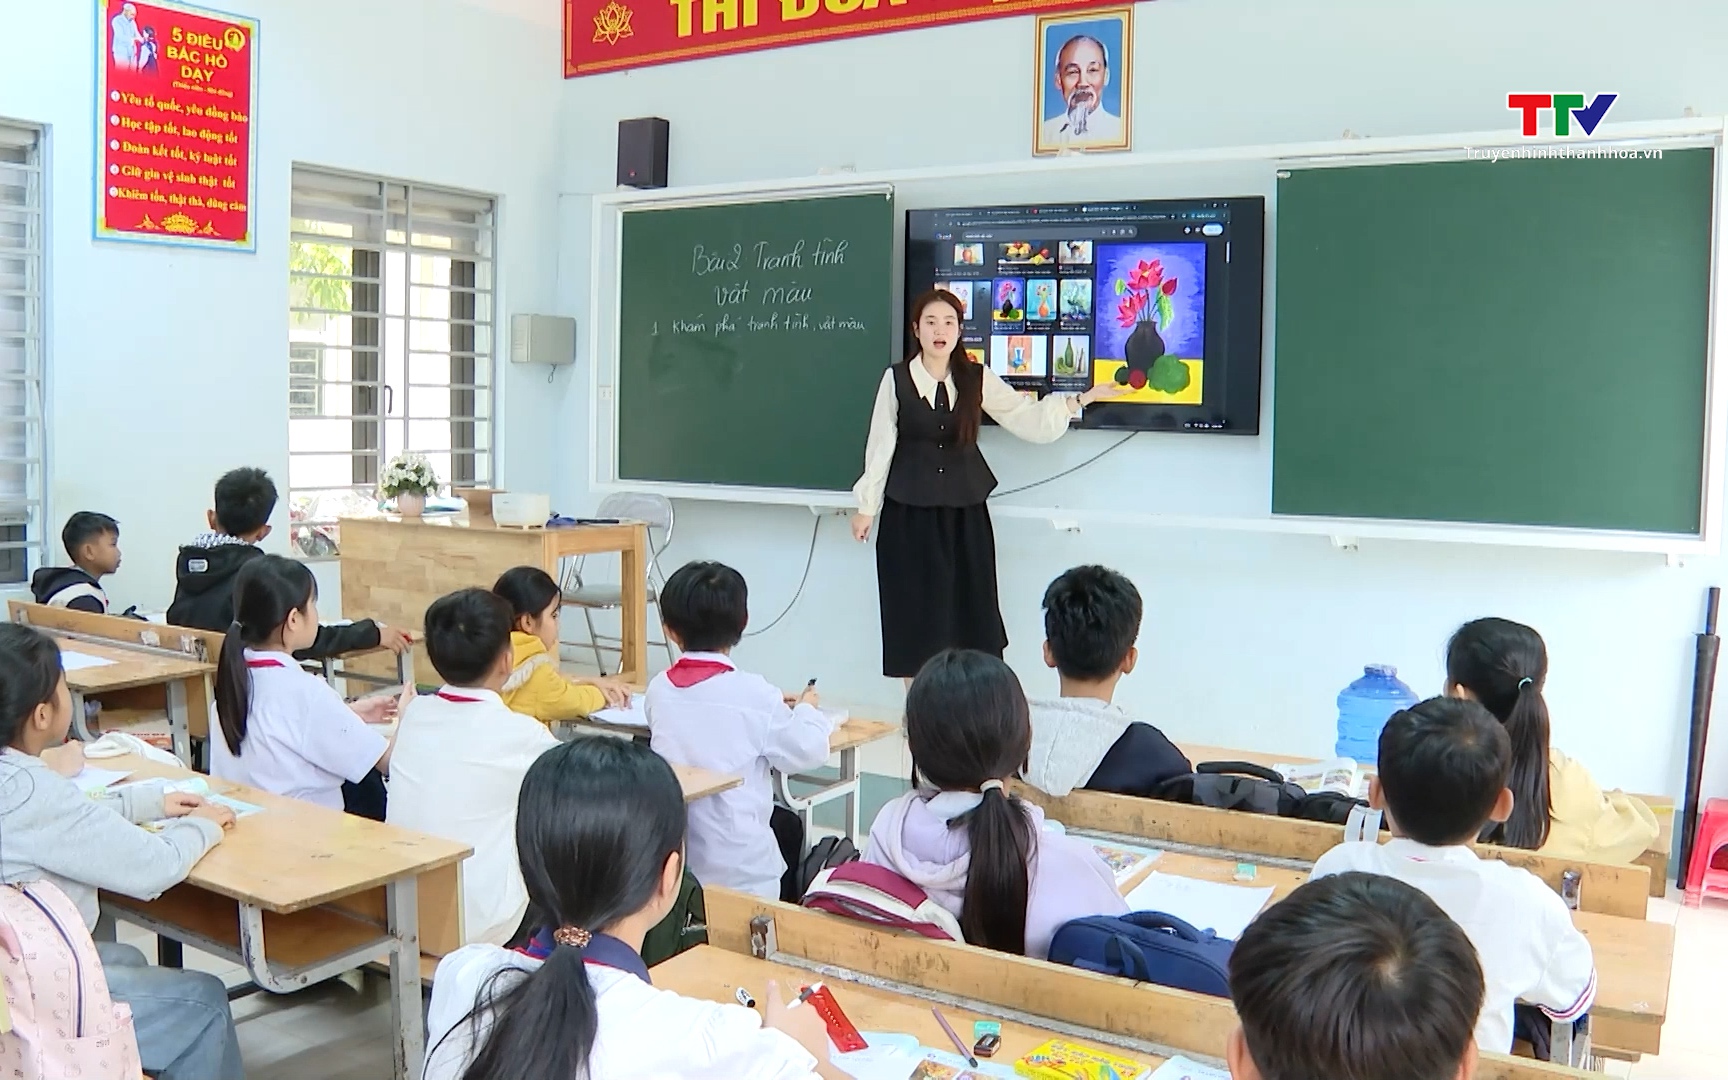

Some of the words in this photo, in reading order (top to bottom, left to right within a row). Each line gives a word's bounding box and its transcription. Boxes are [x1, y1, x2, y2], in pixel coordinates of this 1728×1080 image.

[171, 26, 183, 42] 5
[181, 65, 214, 84] DẠY
[121, 91, 142, 106] Yêu
[121, 117, 142, 132] Học
[182, 126, 197, 138] lao
[199, 129, 223, 144] động
[225, 130, 238, 143] tốt
[224, 154, 237, 167] tốt
[121, 165, 143, 178] Giữ
[176, 172, 196, 184] sinh
[222, 176, 235, 189] tốt
[118, 188, 148, 200] Khiêm
[753, 239, 805, 271] Tranh
[812, 237, 849, 266] tĩnh
